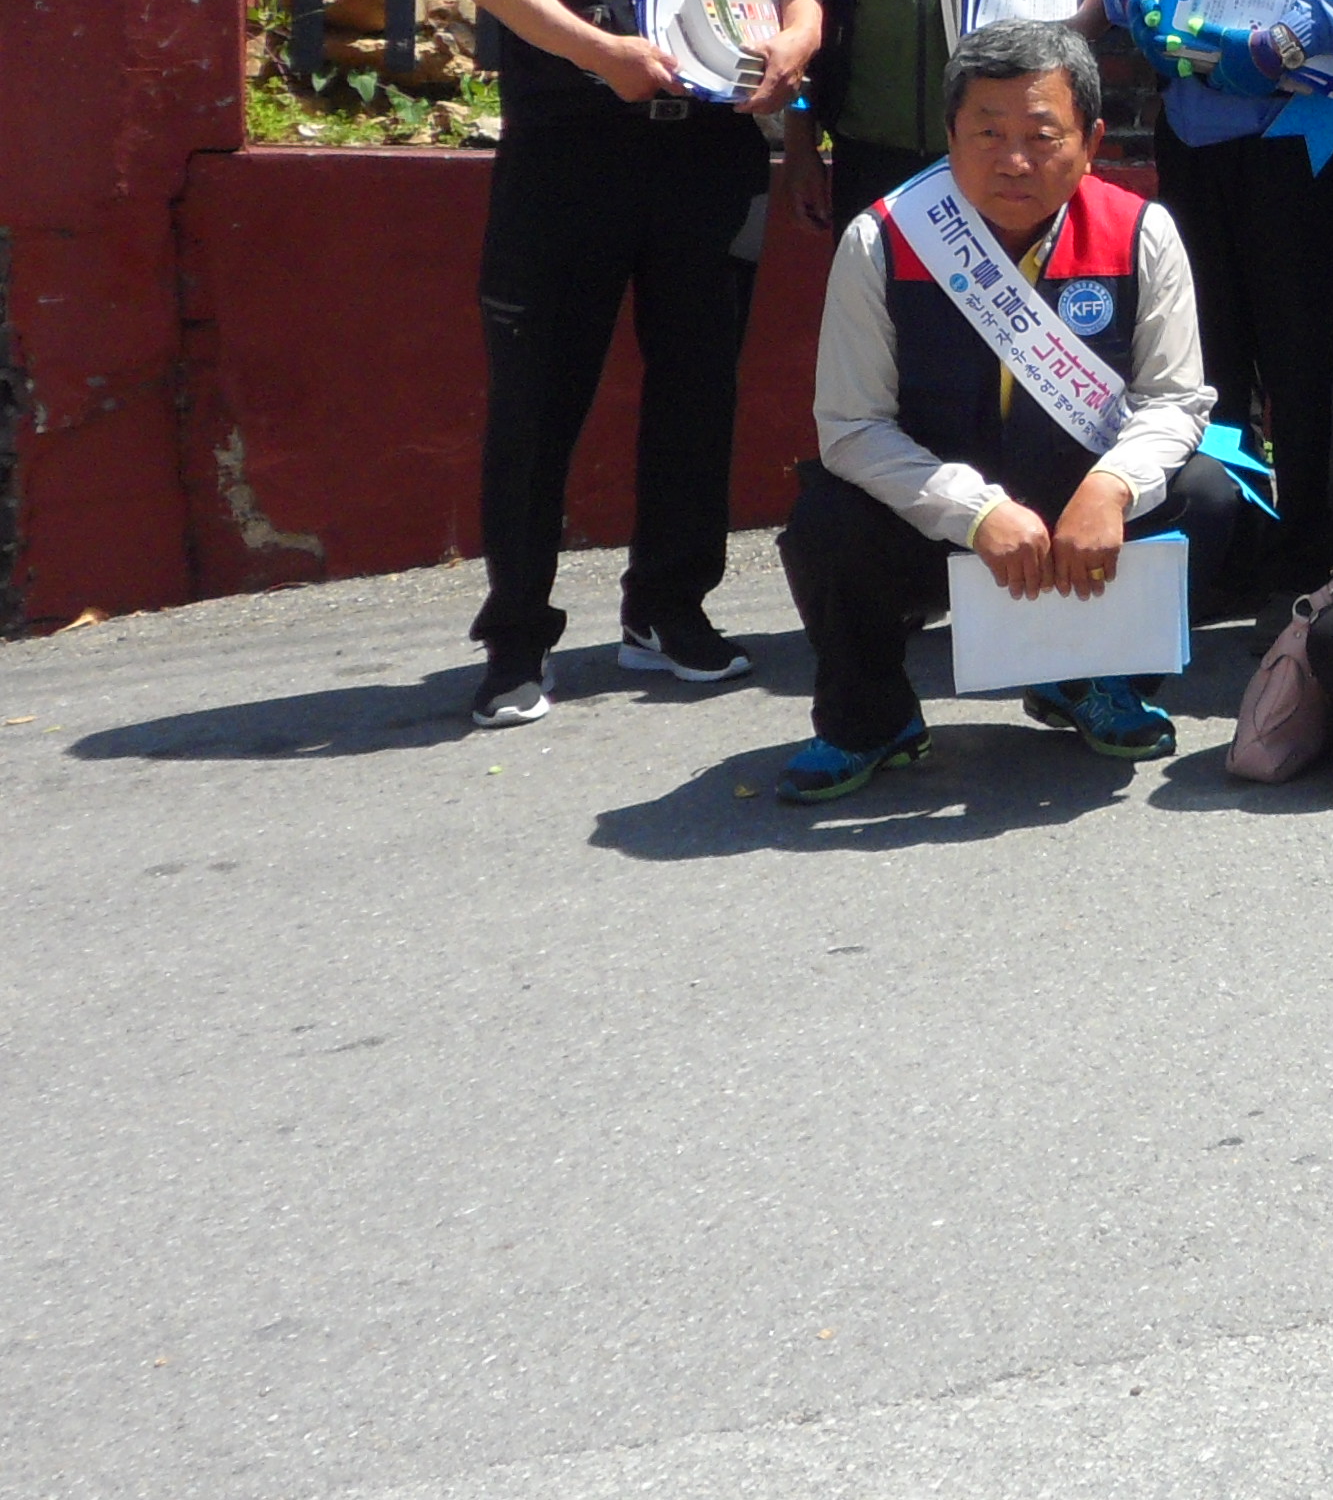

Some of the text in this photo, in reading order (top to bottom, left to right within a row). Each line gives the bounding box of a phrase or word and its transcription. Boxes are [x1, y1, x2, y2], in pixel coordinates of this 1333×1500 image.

[926, 195, 1004, 290] 태극기를
[991, 284, 1043, 334] 달아
[1031, 330, 1116, 414] 나라사랑
[1069, 300, 1105, 317] KFF
